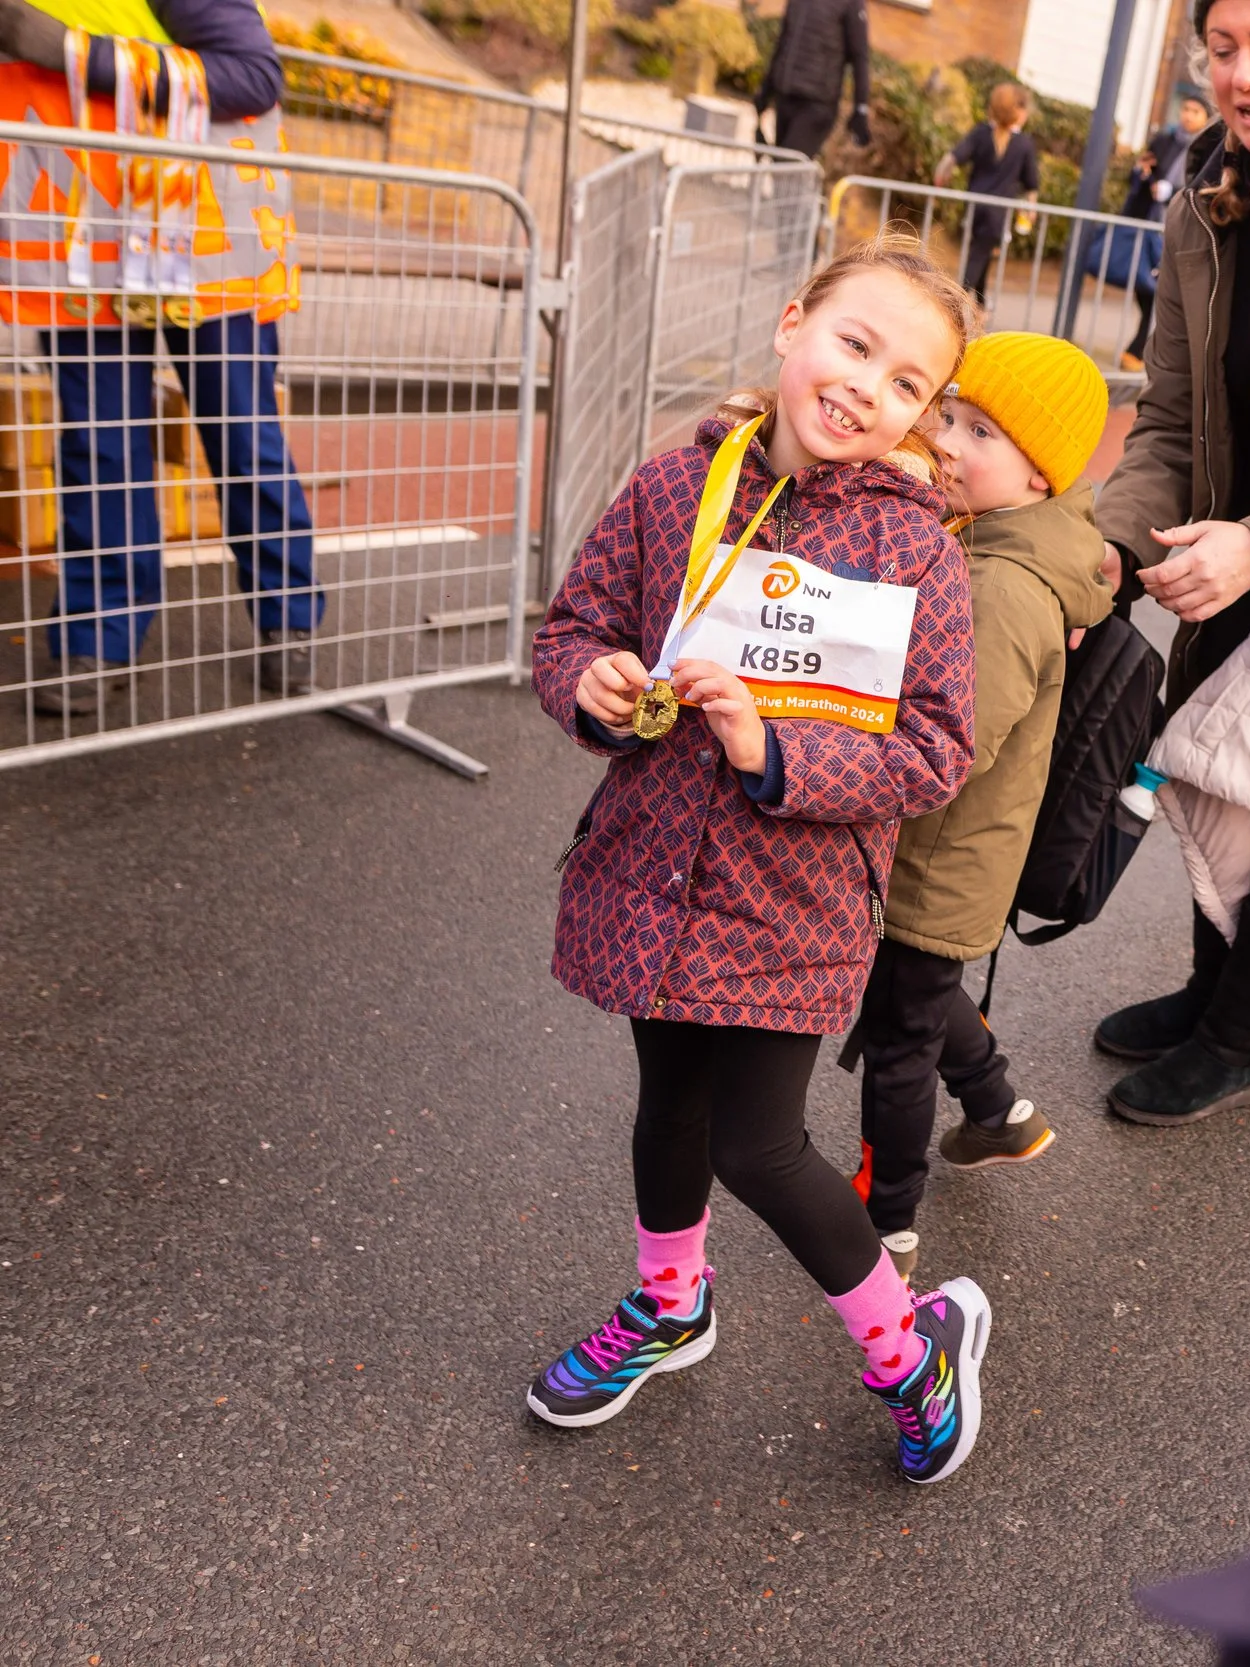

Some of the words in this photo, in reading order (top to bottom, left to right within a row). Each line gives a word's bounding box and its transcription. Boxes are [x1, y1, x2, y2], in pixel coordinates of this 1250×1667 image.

[802, 583, 831, 600] NN
[760, 604, 815, 635] Lisa
[739, 643, 822, 675] K859
[786, 696, 847, 715] Marathon
[849, 706, 885, 724] 2024
